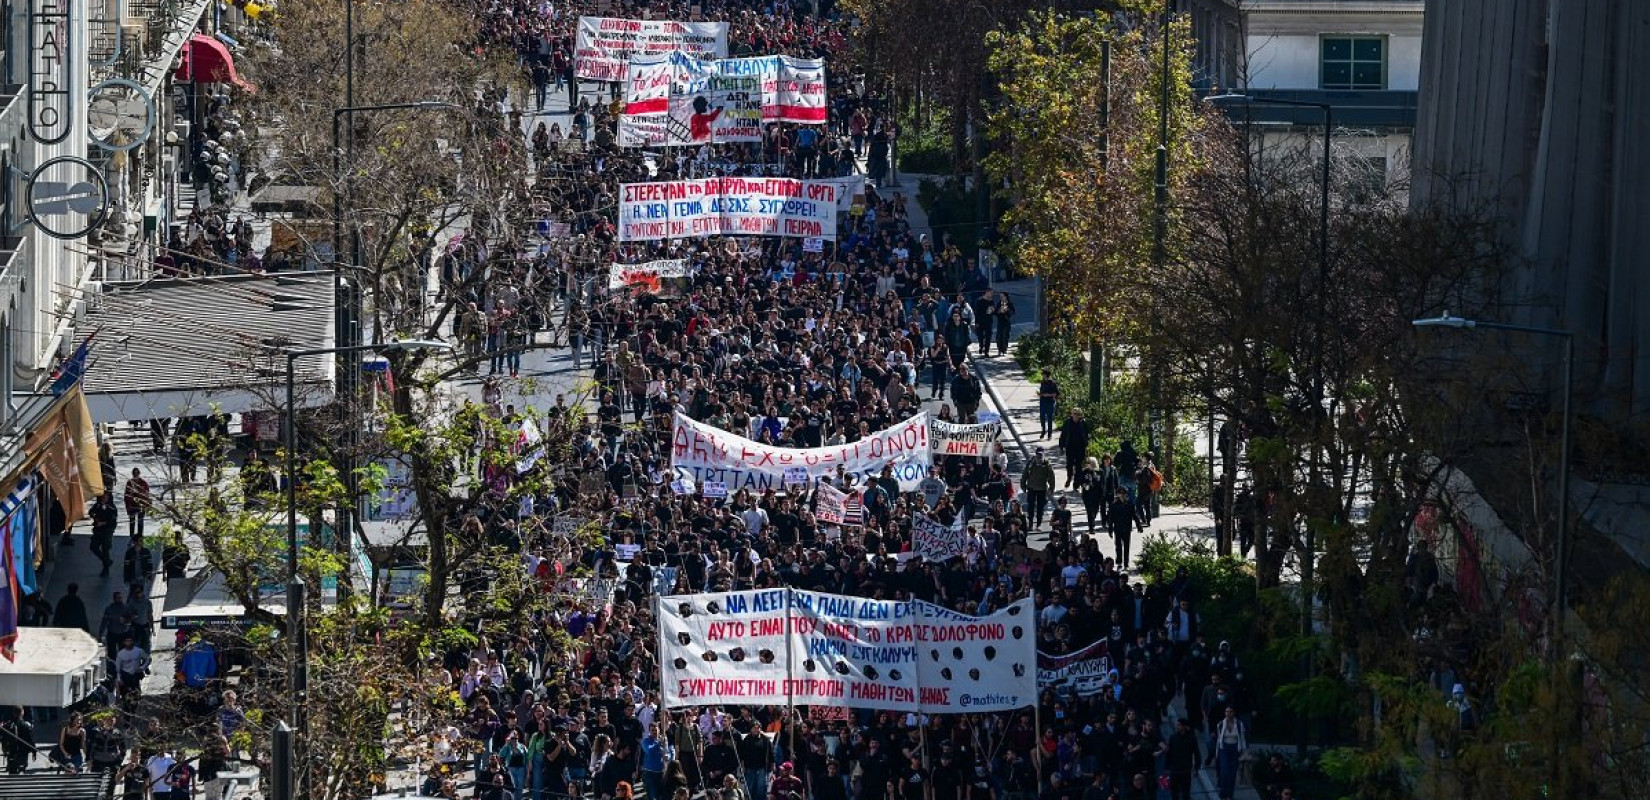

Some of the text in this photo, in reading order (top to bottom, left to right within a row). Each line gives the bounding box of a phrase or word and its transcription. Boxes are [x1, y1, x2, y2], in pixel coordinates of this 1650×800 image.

[625, 183, 686, 202] ΣΤΕΡΕΨΑΝ
[688, 184, 702, 194] ΤΑ
[705, 178, 746, 196] ΔΑΚΡΥΑ
[808, 184, 834, 202] ΟΡΓΗ
[633, 205, 640, 219] Η
[647, 204, 669, 219] ΝΕΑ
[674, 201, 703, 217] ΓΕΝΙΑ
[728, 197, 750, 213] ΣΑΣ
[946, 442, 977, 453] ΑΙΜΑ
[726, 595, 747, 614] ΝΑ
[753, 590, 783, 612] ΛΕΕΙ
[817, 596, 855, 618] ΠΑΙΔΙ
[858, 602, 888, 618] ΔΕΝ
[708, 622, 745, 641] ΑΥΤΟ
[750, 617, 784, 637] ΕΙΝΑΙ
[864, 627, 881, 642] ΤΟ
[931, 624, 1005, 642] ΔΟΛΟΦΟΝΟ
[679, 679, 775, 698] ΣΥΝΤΟΝΙΣΤΙΚΗ
[783, 679, 843, 698] ΕΠΙΤΡΟΠΗ
[850, 684, 914, 702] ΜΑΘΗΤΩΝ
